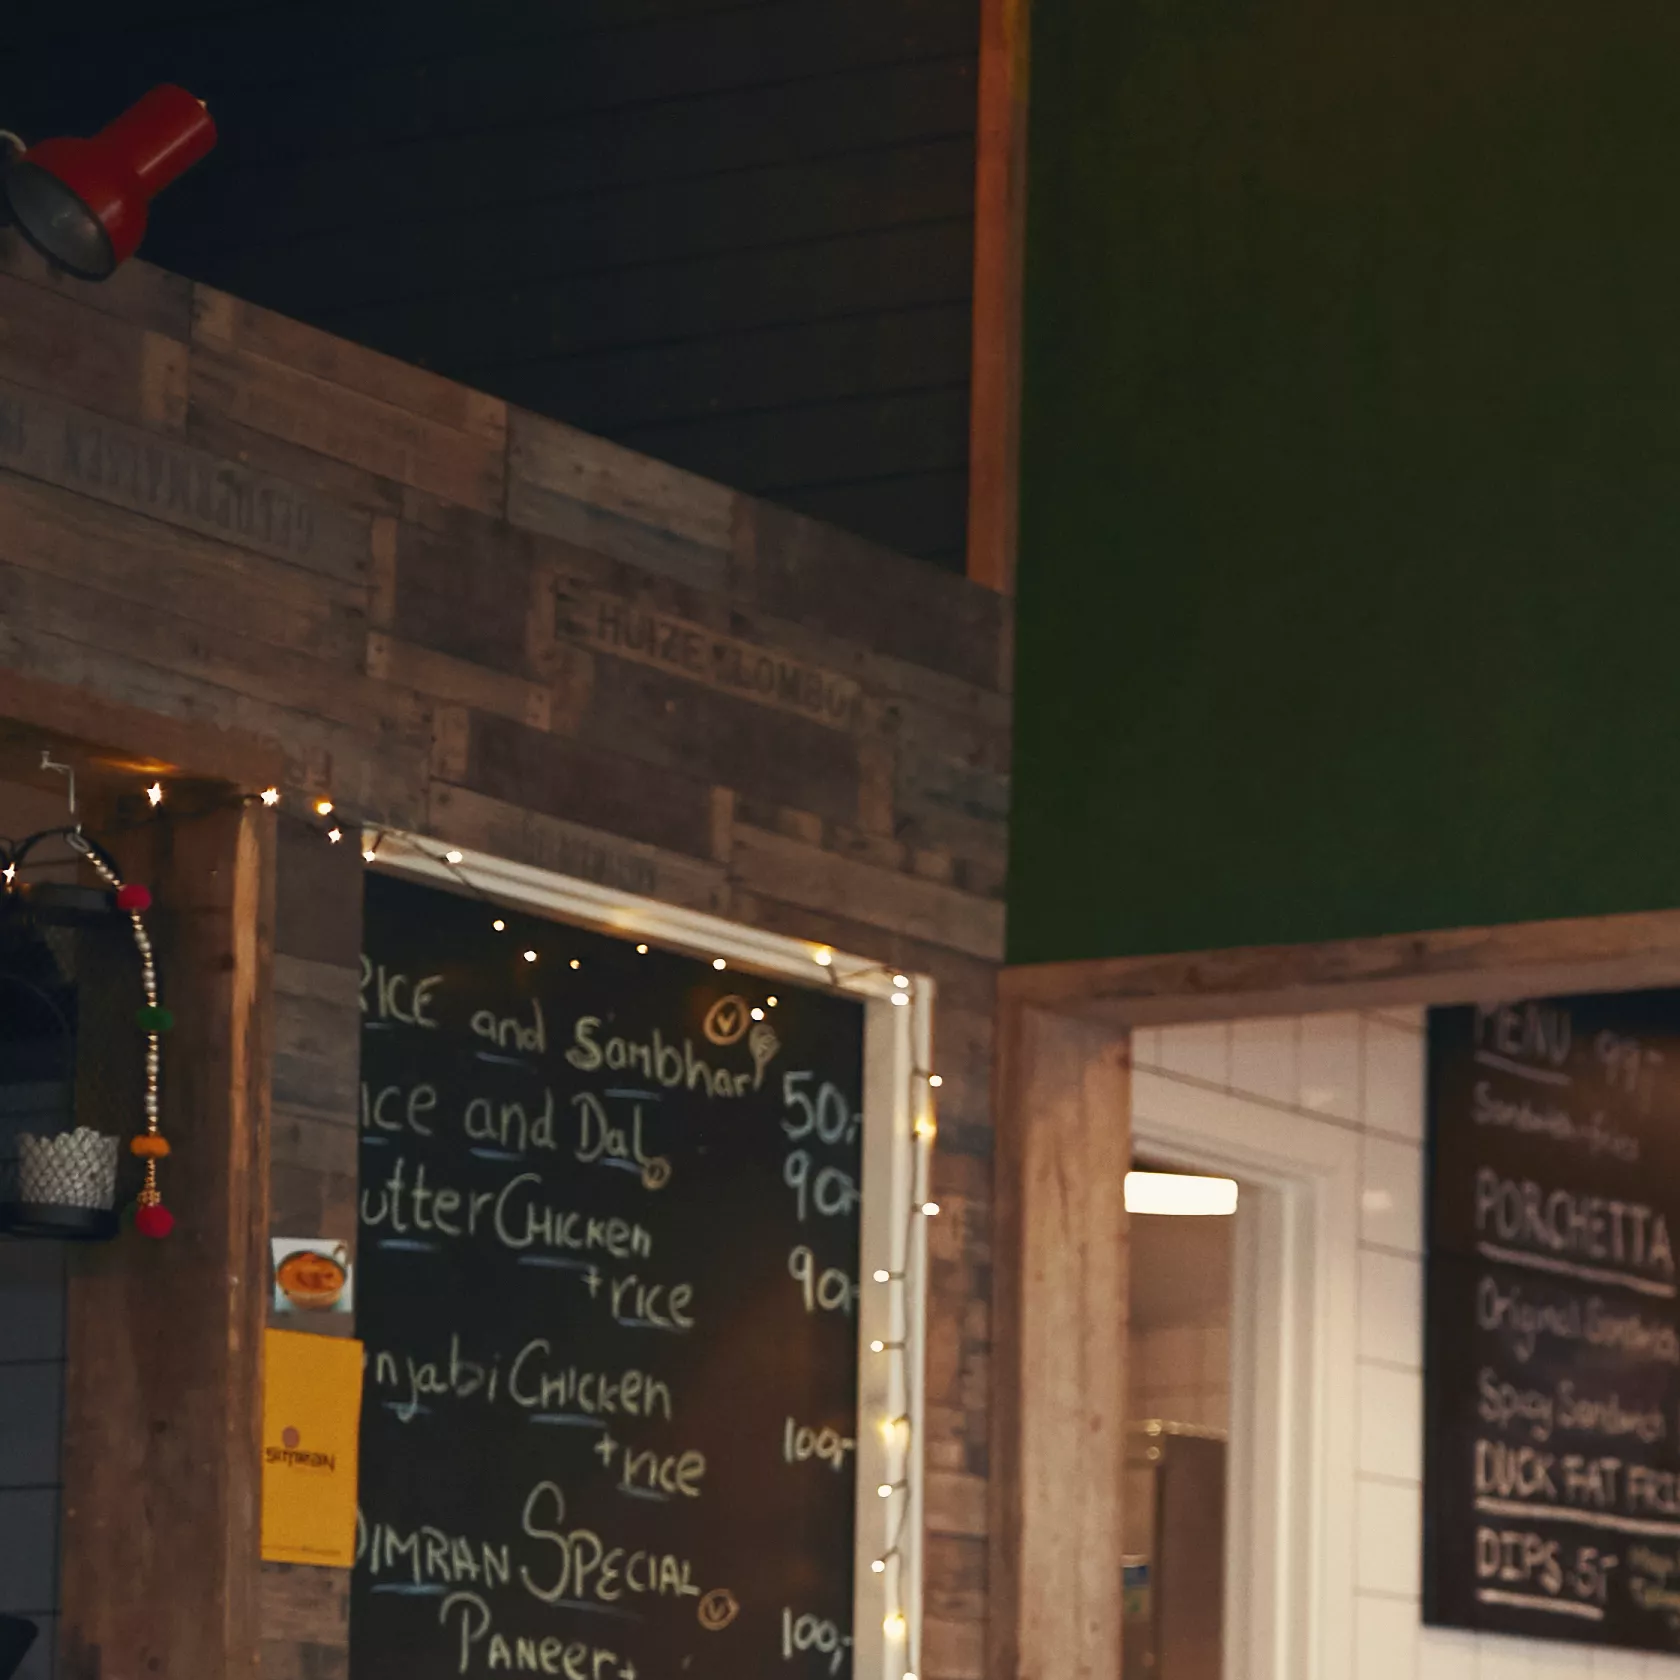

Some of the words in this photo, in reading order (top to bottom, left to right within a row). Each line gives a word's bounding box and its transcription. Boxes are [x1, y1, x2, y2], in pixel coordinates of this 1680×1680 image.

[470, 998, 546, 1054] and
[361, 1080, 438, 1136] ice
[464, 1087, 554, 1151] and
[571, 1091, 652, 1163] Dal
[361, 1157, 494, 1236] utter
[1475, 1439, 1557, 1498] DUCK
[356, 1506, 510, 1589] IMRAN
